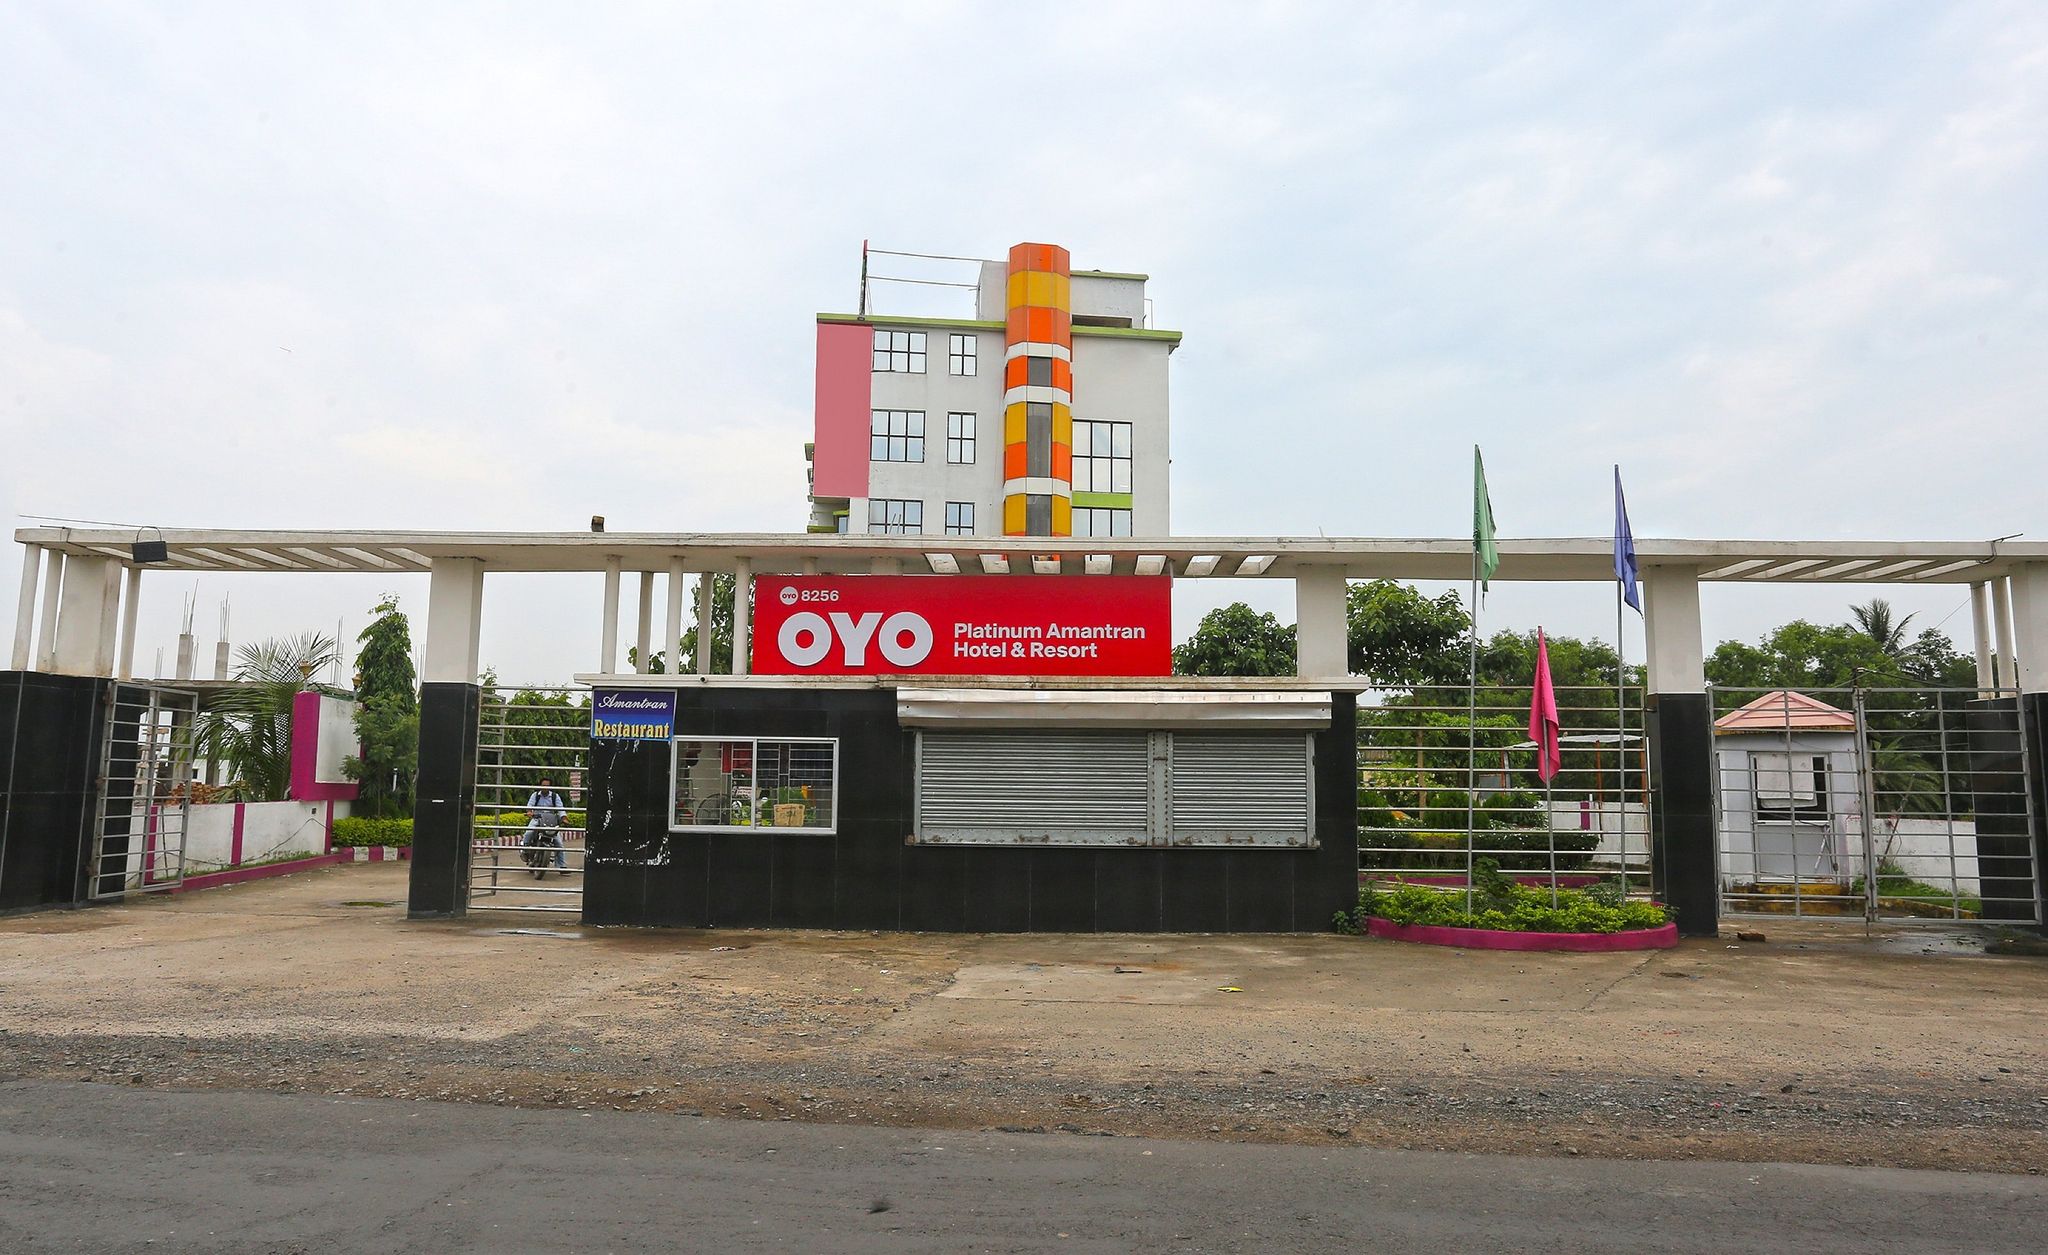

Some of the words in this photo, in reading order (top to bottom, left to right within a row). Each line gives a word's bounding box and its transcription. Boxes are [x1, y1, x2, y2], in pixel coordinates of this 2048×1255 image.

[801, 590, 839, 602] 8256
[777, 611, 934, 667] OYO
[954, 623, 1042, 639] Platinum
[1046, 623, 1146, 639] Amantran
[954, 642, 1006, 658] Hotel
[1010, 642, 1026, 658] &
[1030, 643, 1098, 658] Resort
[598, 692, 668, 708] Amantran
[594, 719, 670, 738] Restaurant
